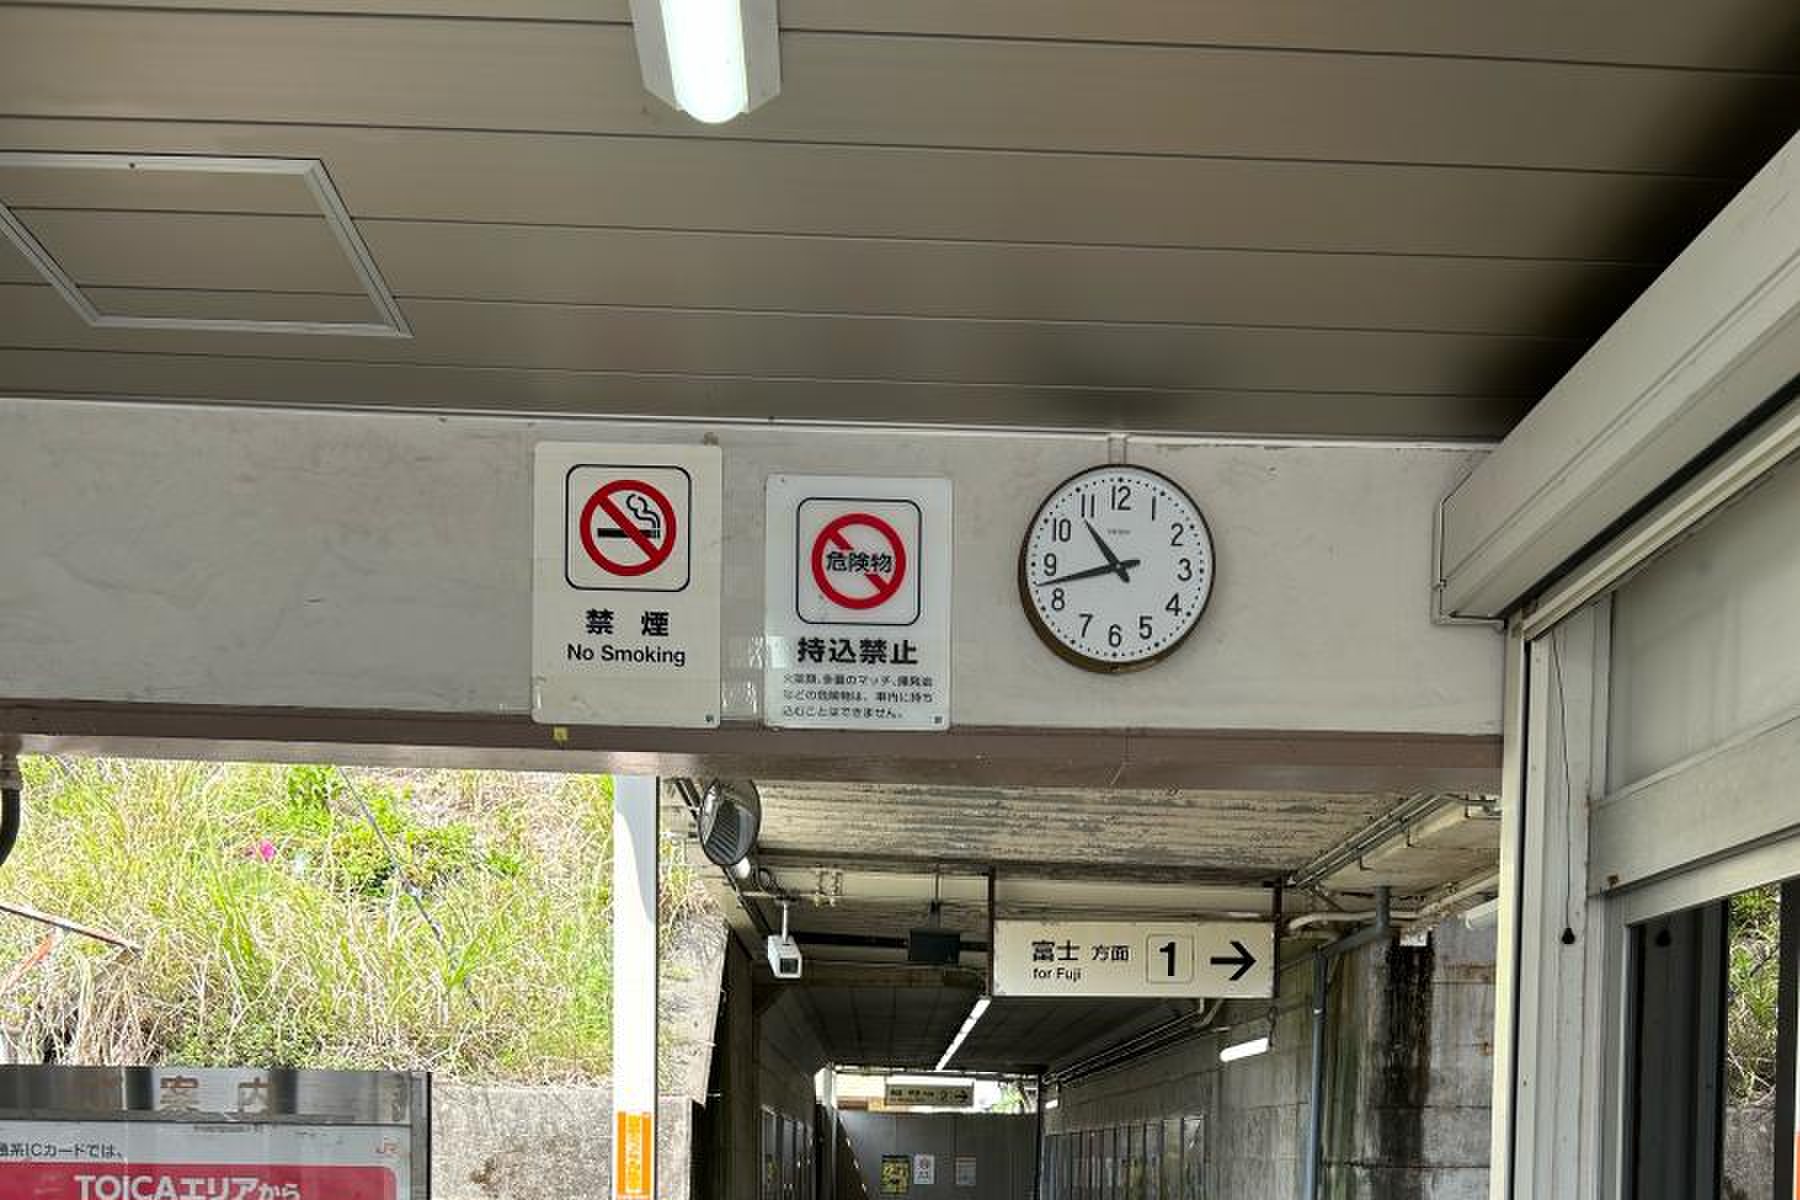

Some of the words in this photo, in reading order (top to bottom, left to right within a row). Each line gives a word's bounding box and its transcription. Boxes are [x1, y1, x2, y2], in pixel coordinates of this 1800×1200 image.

[1080, 494, 1095, 518] 11
[1111, 485, 1131, 511] 12
[1151, 496, 1157, 521] 1
[1052, 518, 1072, 542] 10
[1170, 523, 1184, 546] 2
[826, 551, 892, 573] 危険物
[1043, 553, 1057, 576] 9
[1177, 558, 1192, 581] 3
[1051, 588, 1065, 611] 8
[1165, 593, 1182, 616] 4
[1078, 613, 1093, 637] 7
[1108, 624, 1122, 647] 6
[1139, 616, 1153, 640] 5
[567, 643, 595, 660] No
[601, 644, 686, 667] Smoking
[797, 636, 919, 664] 持込禁止
[1031, 940, 1080, 962] 富士
[1091, 944, 1130, 962] 方面
[1159, 942, 1176, 976] 1
[1033, 967, 1052, 979] for
[1056, 968, 1081, 982] Fuji
